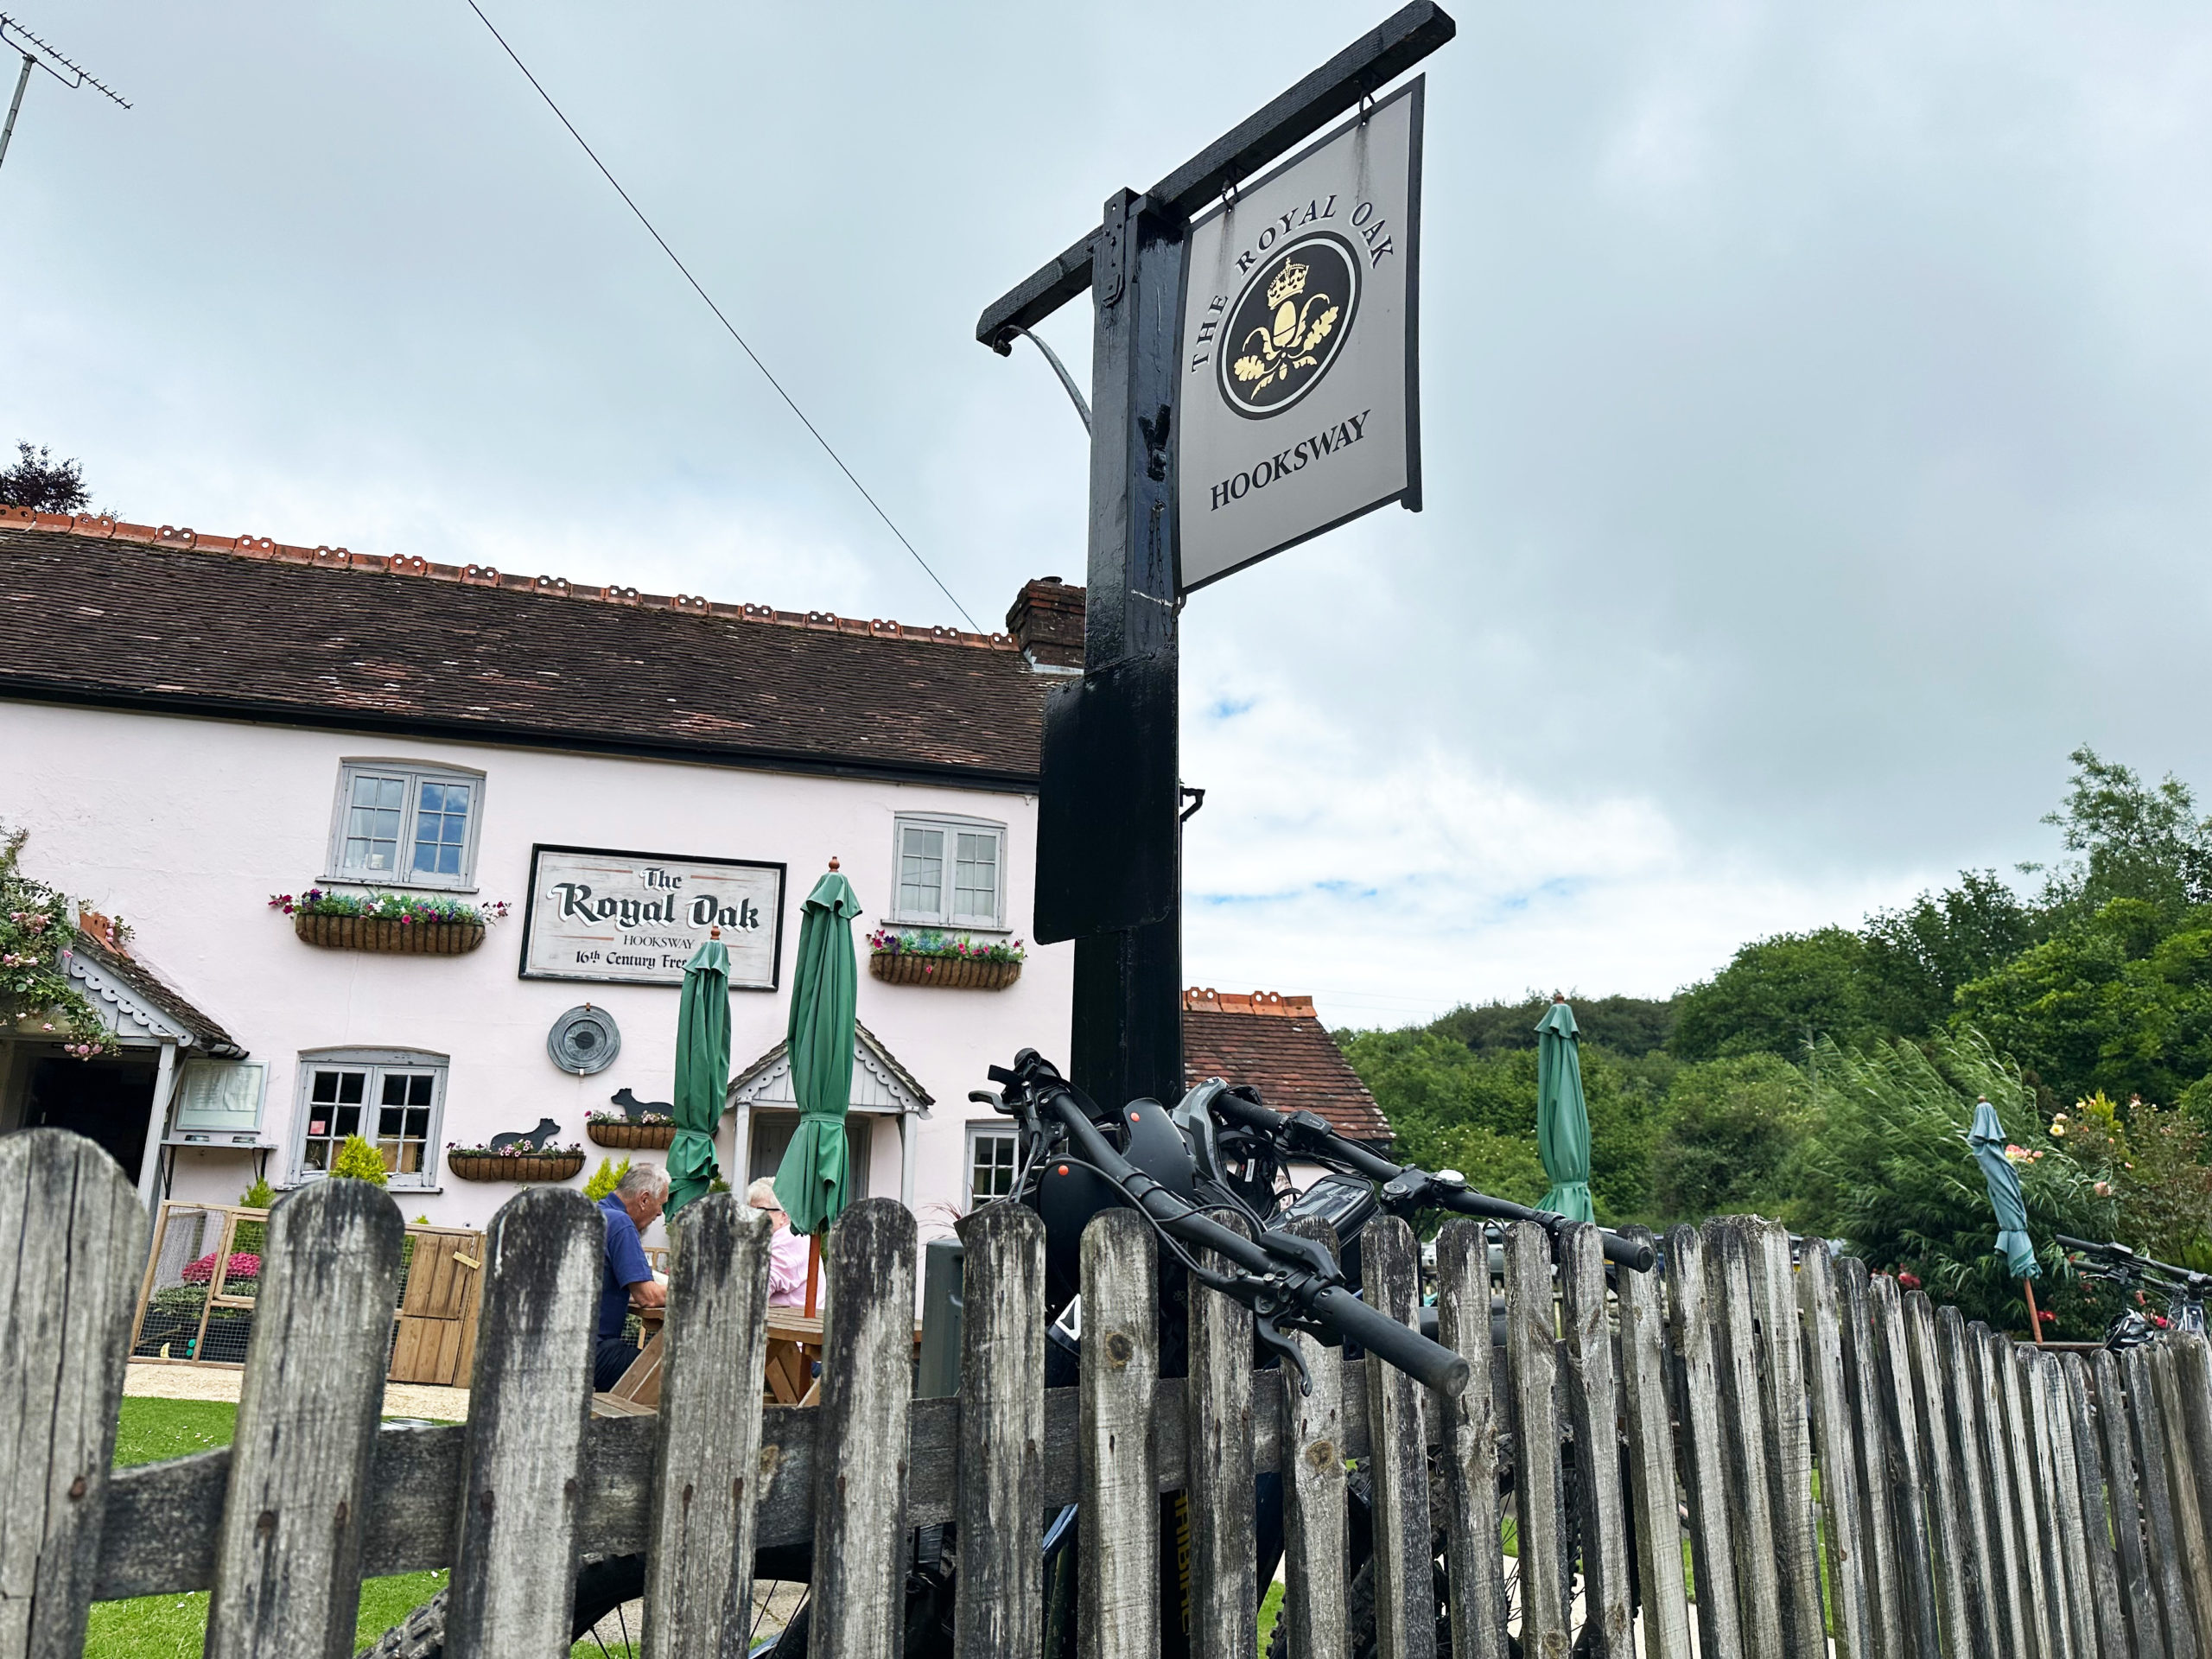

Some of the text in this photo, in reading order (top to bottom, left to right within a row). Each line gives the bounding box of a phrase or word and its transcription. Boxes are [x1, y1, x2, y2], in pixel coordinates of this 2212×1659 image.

[1192, 194, 1394, 373] THE ROYAL OAK
[1210, 409, 1371, 512] HOOKSWAY
[640, 867, 683, 890] The
[547, 882, 760, 932] Royal Oak
[576, 950, 601, 963] 16th
[606, 951, 656, 969] Century
[623, 935, 696, 949] HOOKSWAY
